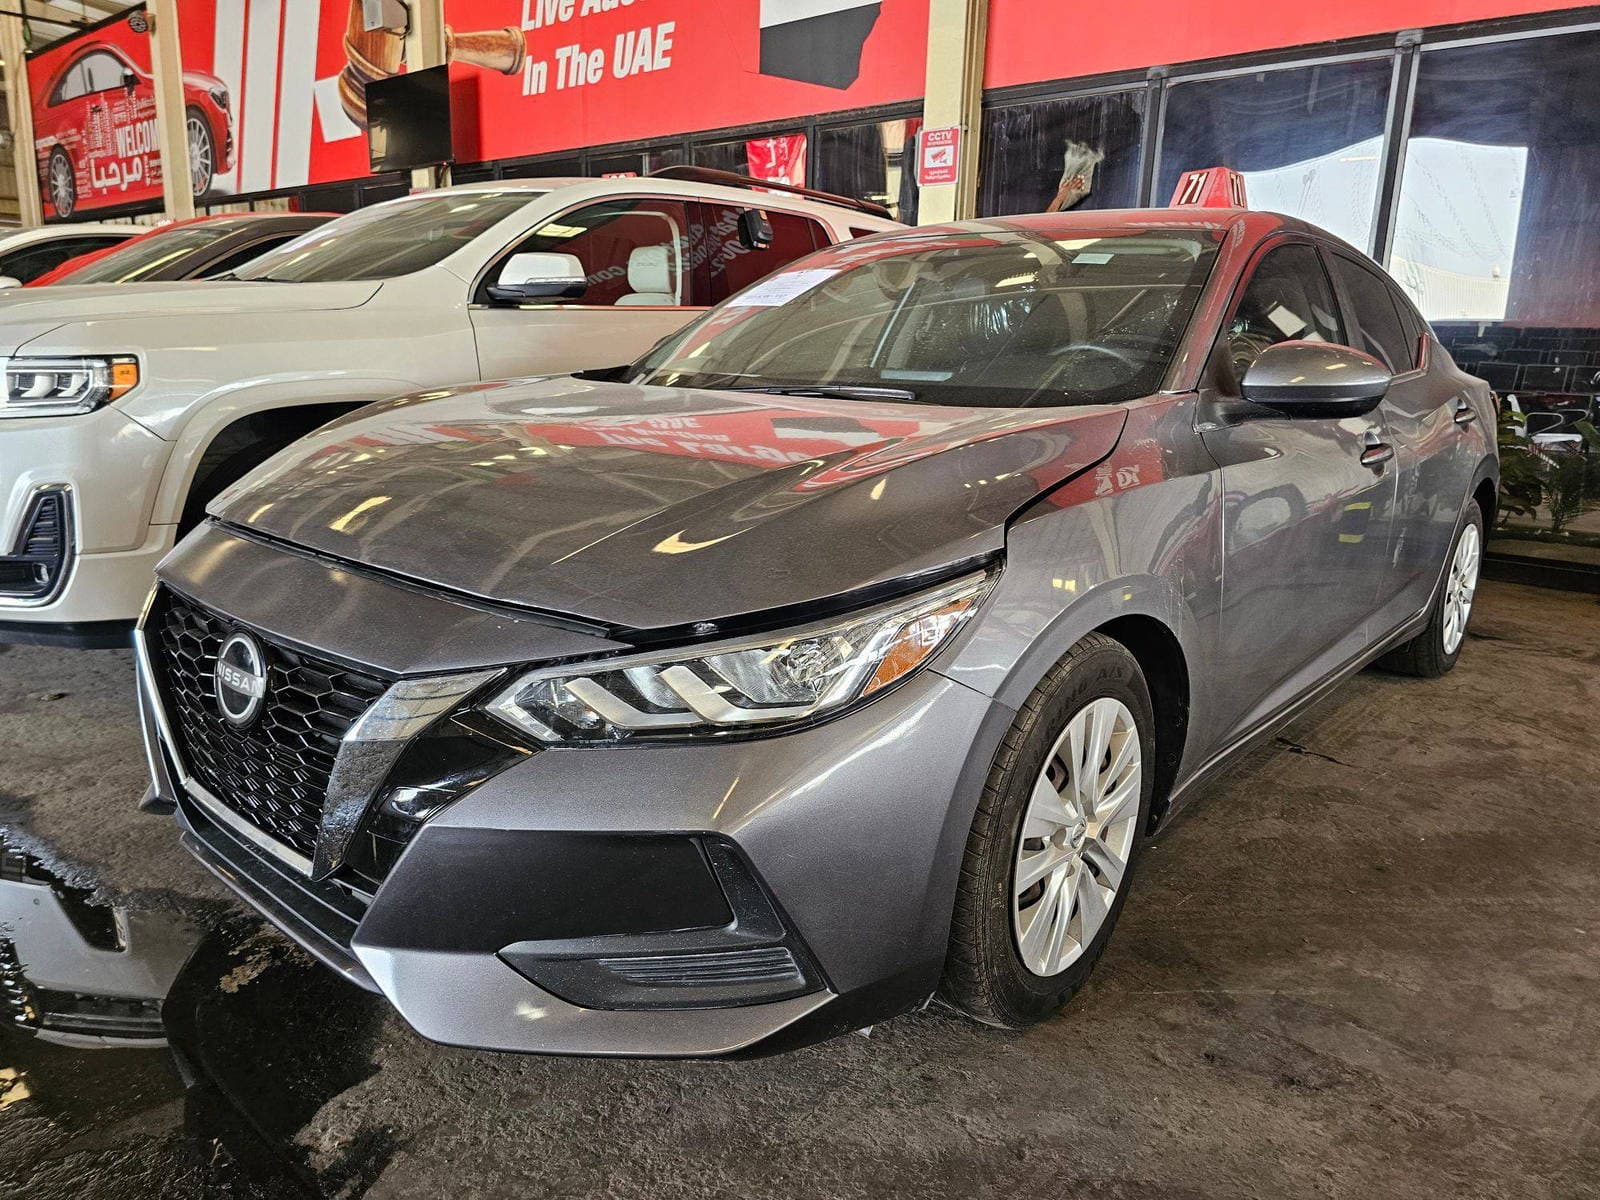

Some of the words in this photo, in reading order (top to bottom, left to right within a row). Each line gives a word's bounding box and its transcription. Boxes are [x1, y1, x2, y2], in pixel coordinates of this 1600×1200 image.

[520, 0, 575, 31] Live
[522, 55, 548, 96] In
[555, 44, 605, 90] The
[613, 21, 676, 79] UAE
[115, 118, 160, 159] WELCOM
[927, 131, 953, 141] CCTV
[90, 156, 143, 195] مرحبا
[1179, 172, 1208, 205] 71
[1230, 173, 1244, 207] 71
[216, 660, 263, 697] NISSAN
